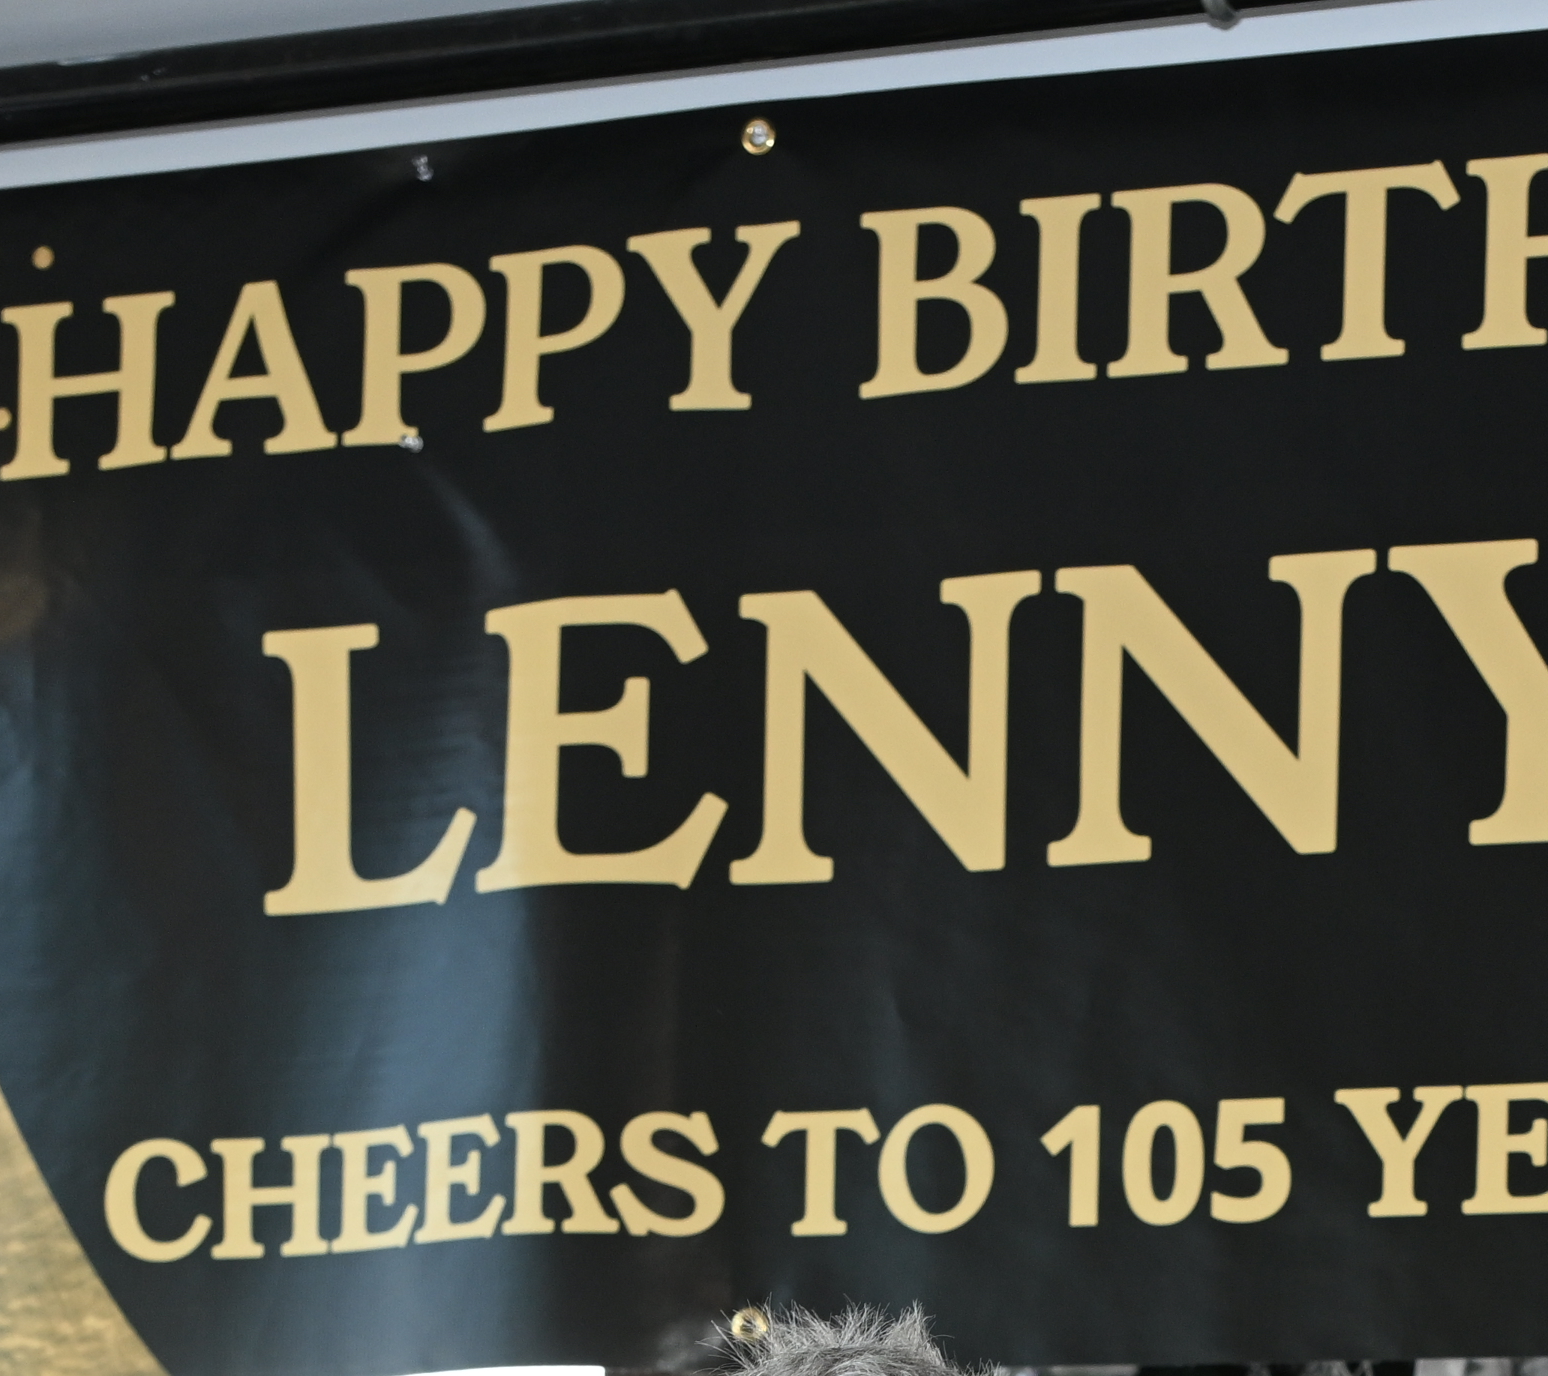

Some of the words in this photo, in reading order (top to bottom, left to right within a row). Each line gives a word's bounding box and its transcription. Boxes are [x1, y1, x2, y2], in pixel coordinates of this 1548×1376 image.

[104, 1108, 726, 1261] CHEERS
[761, 1103, 996, 1236] TO
[1042, 1097, 1293, 1227] 105
